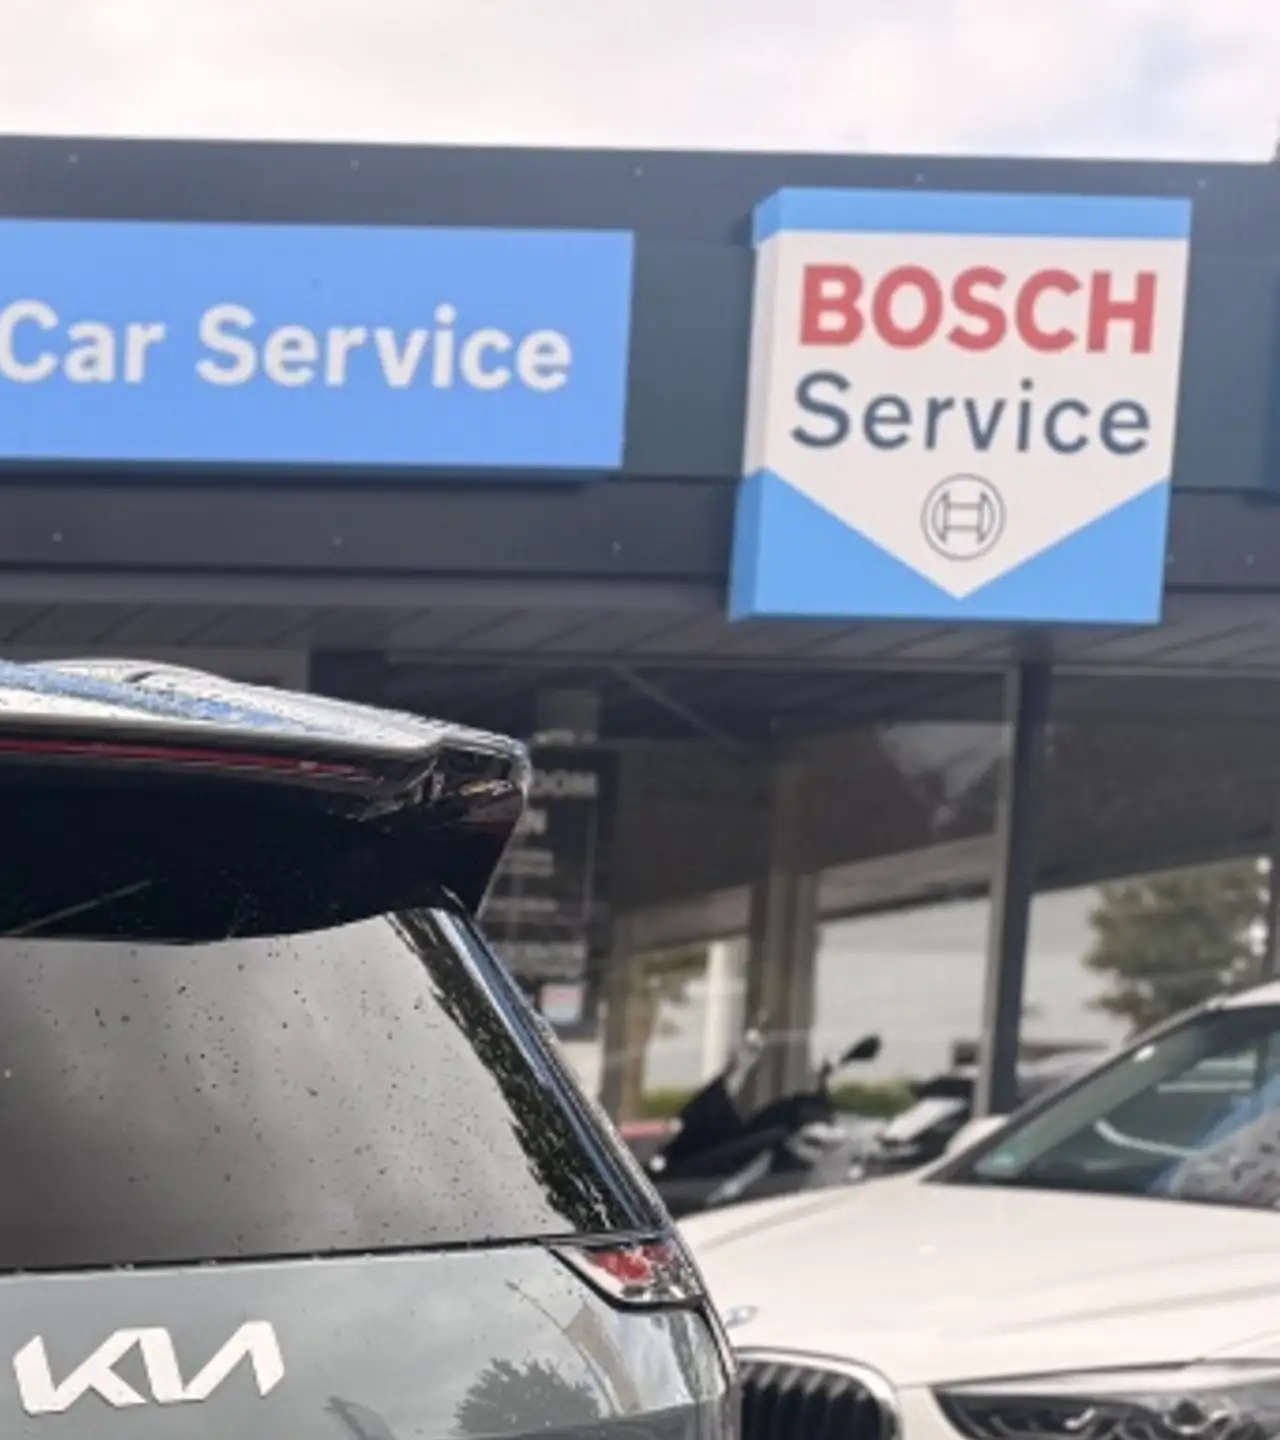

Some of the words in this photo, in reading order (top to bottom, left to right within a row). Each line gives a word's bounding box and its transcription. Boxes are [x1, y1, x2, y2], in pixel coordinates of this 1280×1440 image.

[195, 303, 572, 392] Service
[798, 262, 1158, 355] BOSCH
[789, 369, 1151, 456] Service
